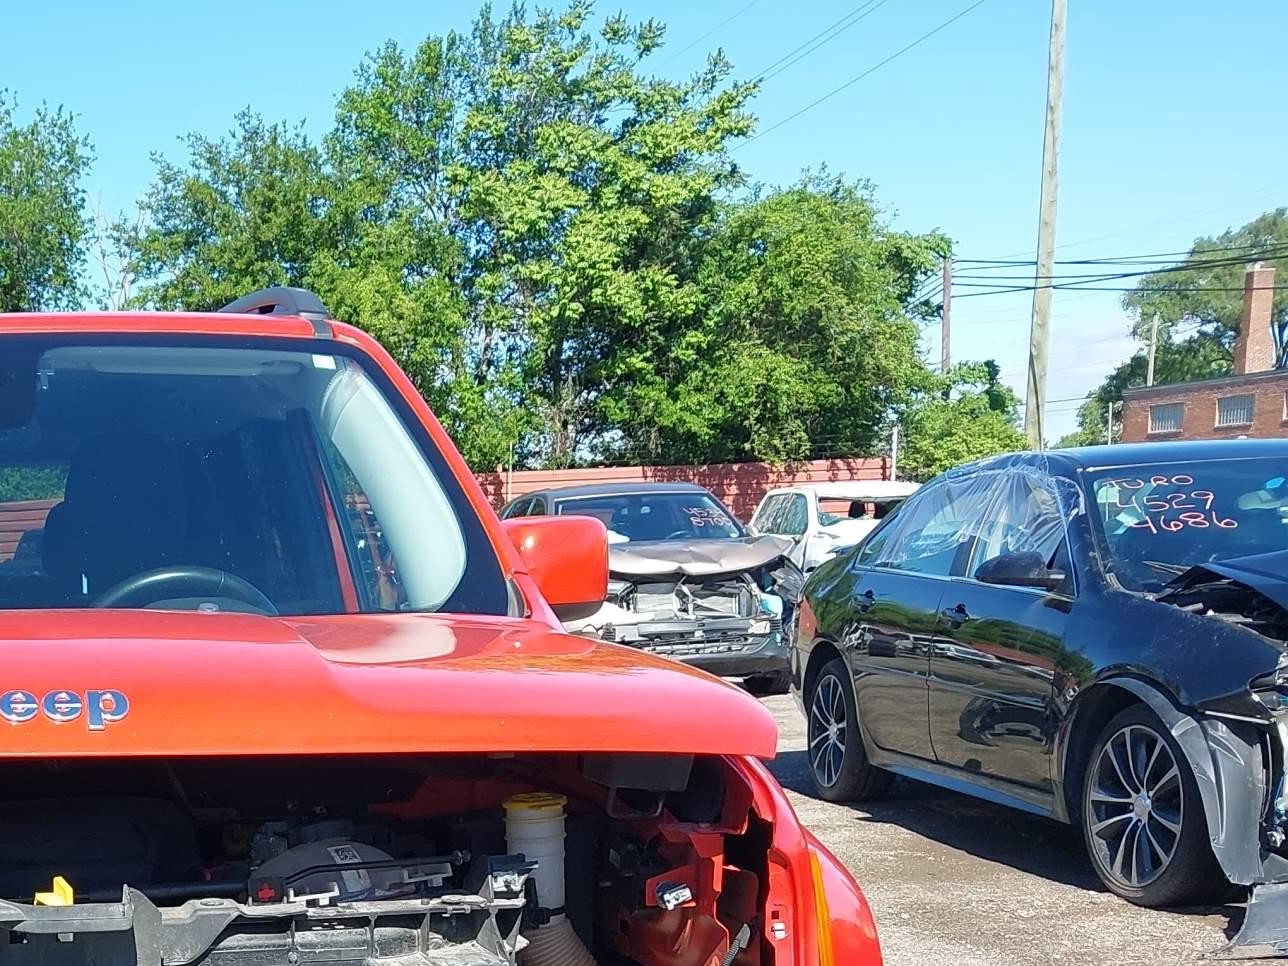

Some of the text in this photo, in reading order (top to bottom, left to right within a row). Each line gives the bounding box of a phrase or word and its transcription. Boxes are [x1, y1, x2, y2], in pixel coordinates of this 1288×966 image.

[1103, 475, 1193, 490] TURO
[1116, 490, 1215, 513] 4529
[1131, 511, 1239, 535] 4686
